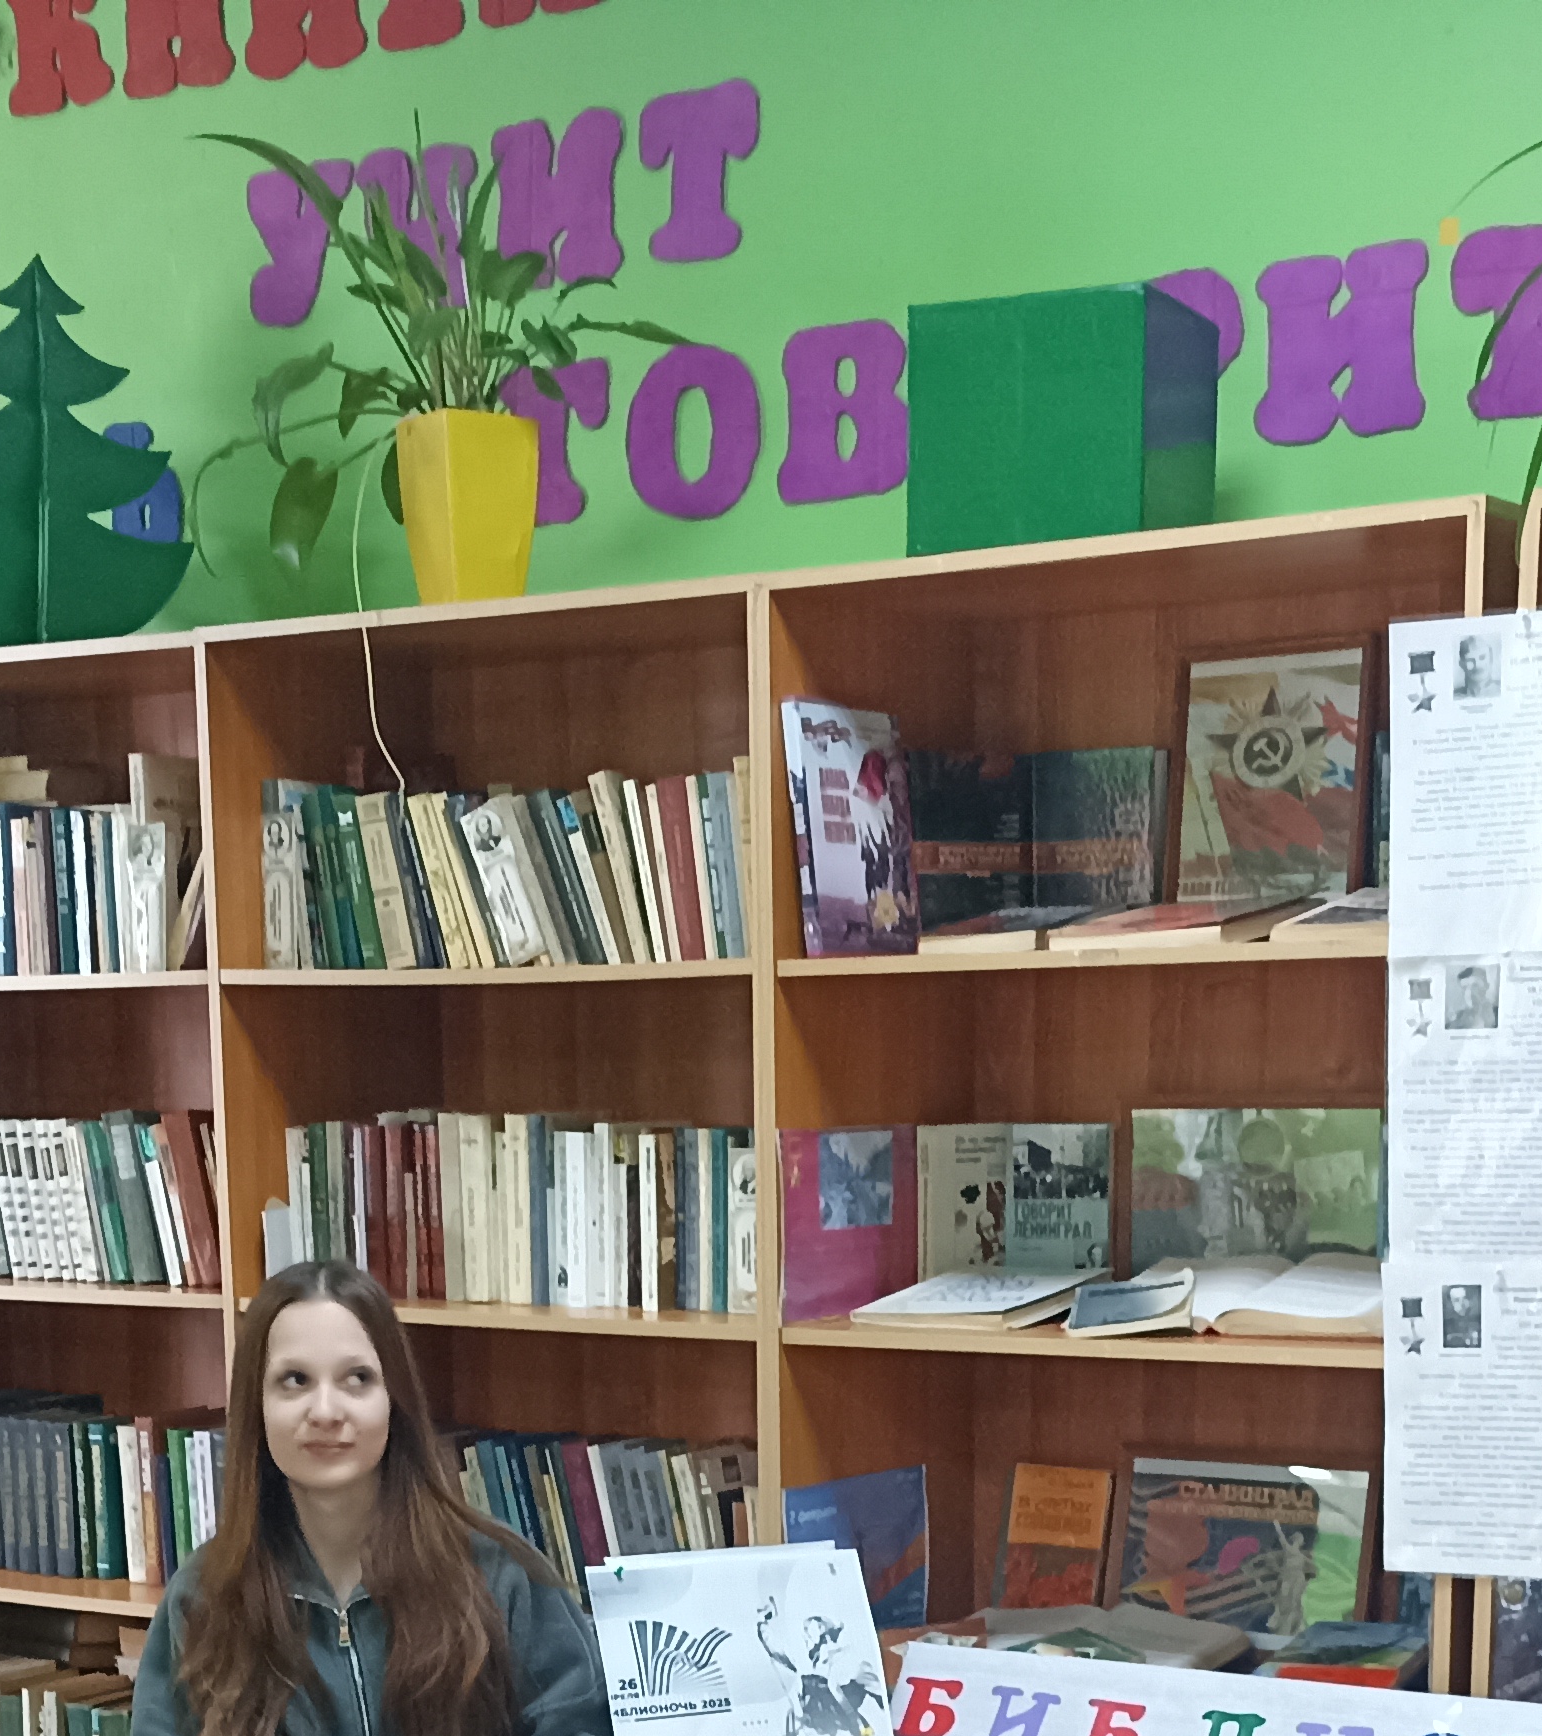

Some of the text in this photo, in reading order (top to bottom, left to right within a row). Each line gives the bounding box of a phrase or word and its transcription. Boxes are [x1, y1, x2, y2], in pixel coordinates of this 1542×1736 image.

[9, 0, 609, 117] КНИ
[246, 78, 760, 327] УЧИТ
[618, 1678, 638, 1691] 26
